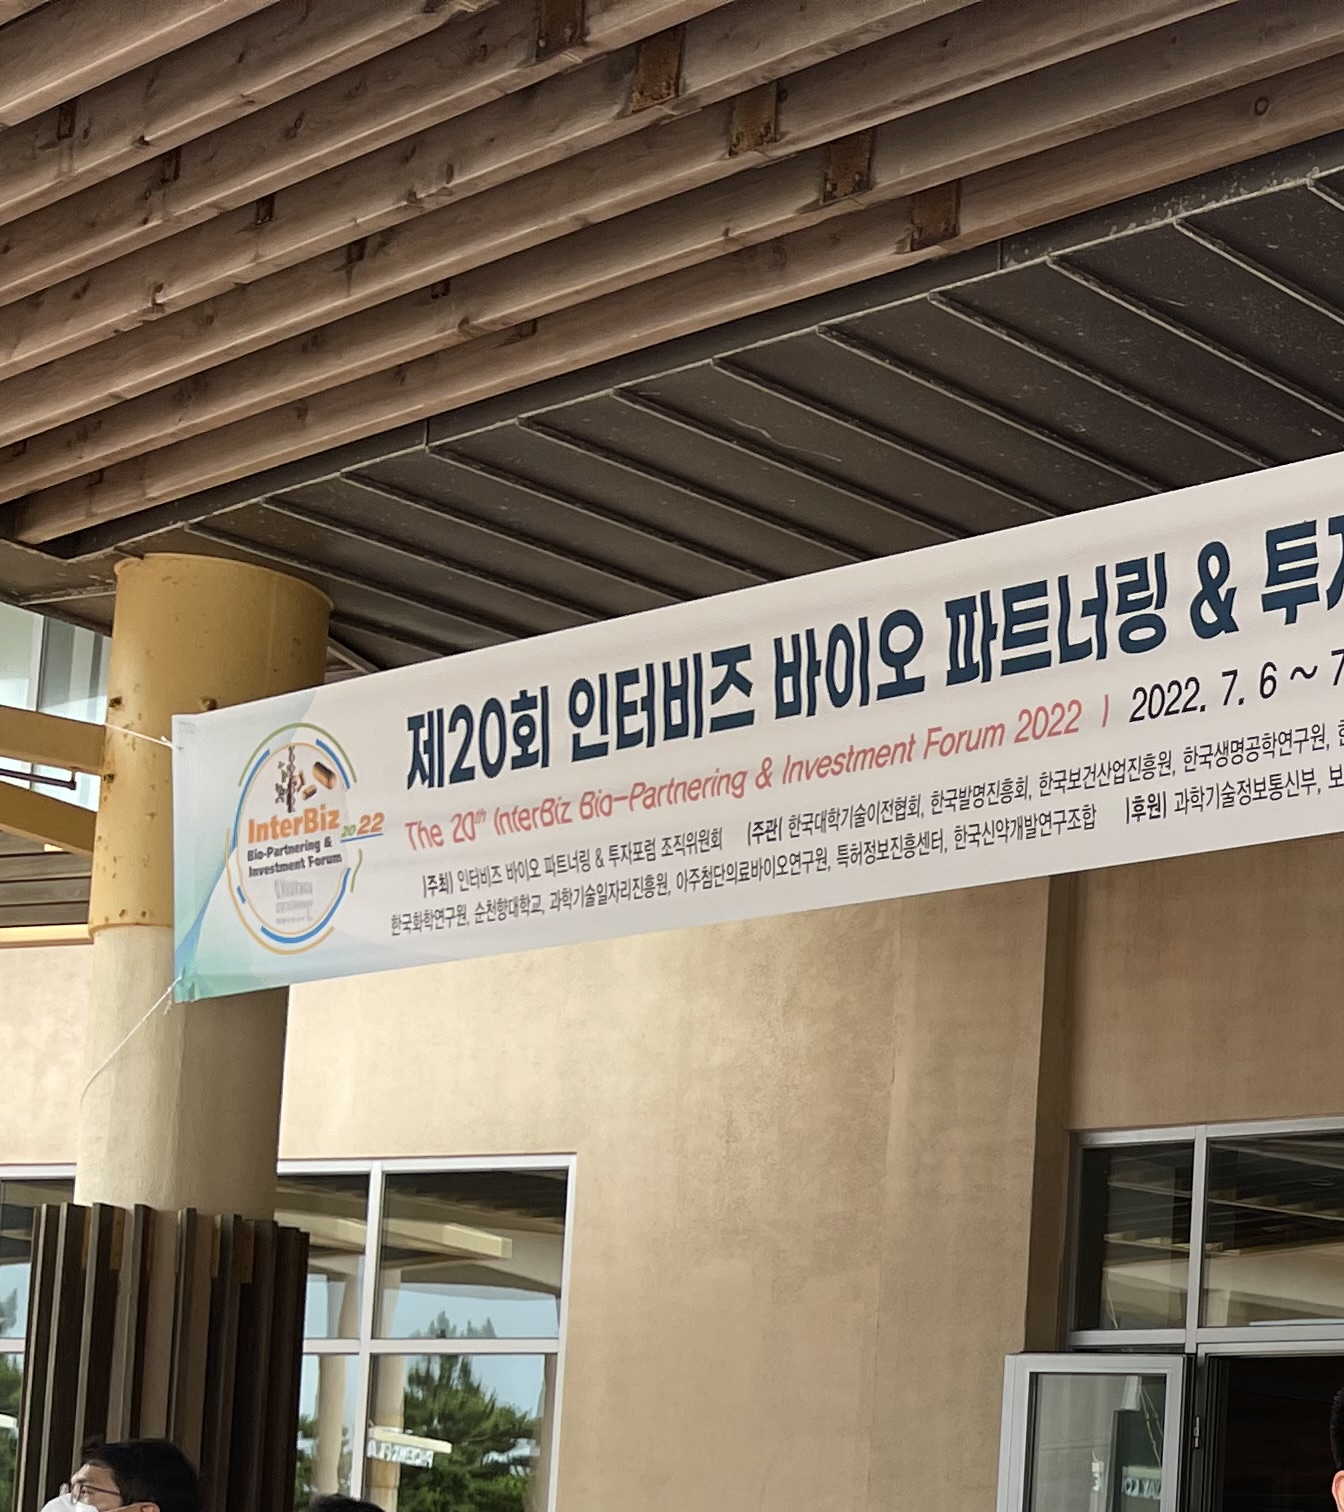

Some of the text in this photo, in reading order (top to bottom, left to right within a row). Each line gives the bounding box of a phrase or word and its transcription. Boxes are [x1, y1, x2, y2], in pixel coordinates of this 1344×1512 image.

[407, 685, 551, 789] 제20회
[567, 644, 756, 763] 인터비즈
[773, 608, 926, 719] 바이오
[944, 551, 1168, 687] 파트너링
[1190, 540, 1241, 639] &
[405, 821, 445, 851] The
[450, 807, 487, 844] 20th
[494, 797, 573, 836] InterBiz
[579, 768, 748, 820] Bio-Partnering
[755, 756, 773, 789] &
[782, 733, 916, 785] Investment
[922, 722, 1006, 760] Forum
[1014, 699, 1083, 744] 2022
[1129, 676, 1207, 723] 2022.
[1221, 668, 1245, 707] 7.
[1259, 661, 1277, 700] 6
[247, 836, 333, 862] Bio-Partnering &
[248, 804, 341, 844] InterBiz
[248, 851, 342, 878] Investment Forum
[457, 864, 502, 892] 인터비즈
[506, 860, 542, 886] 바이오
[545, 849, 592, 879] 파트너링
[595, 848, 605, 869] &
[608, 838, 657, 867] 투자포럼
[660, 826, 723, 858] 조직위원회
